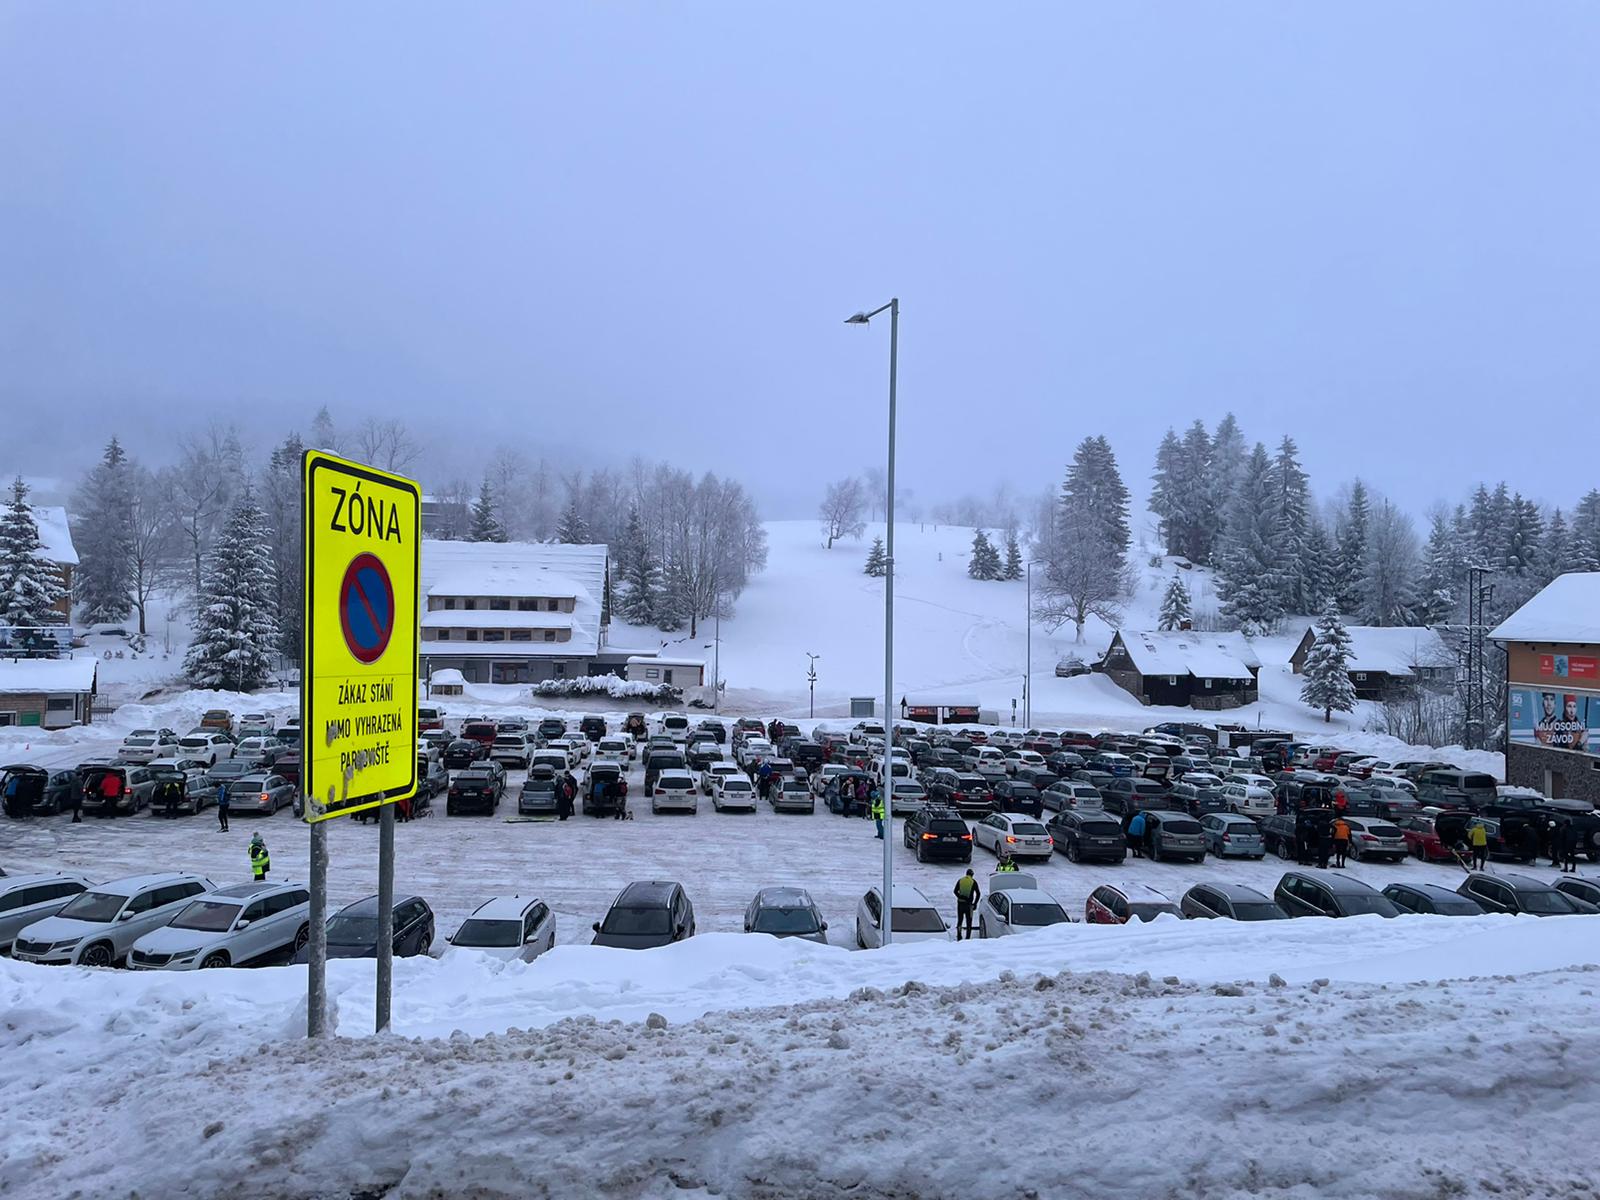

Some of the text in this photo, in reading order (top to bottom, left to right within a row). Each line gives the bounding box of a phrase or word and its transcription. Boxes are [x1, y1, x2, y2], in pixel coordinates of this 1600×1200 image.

[331, 481, 401, 544] ZÓNA
[338, 678, 394, 705] ZÁKAZ STÁNÍ
[355, 707, 402, 736] VYHRAZENÁ
[1536, 719, 1586, 731] MŮJ OSOBNÍ
[1546, 732, 1574, 743] ZÁVOD
[340, 741, 389, 772] PAROIŠTĚ
